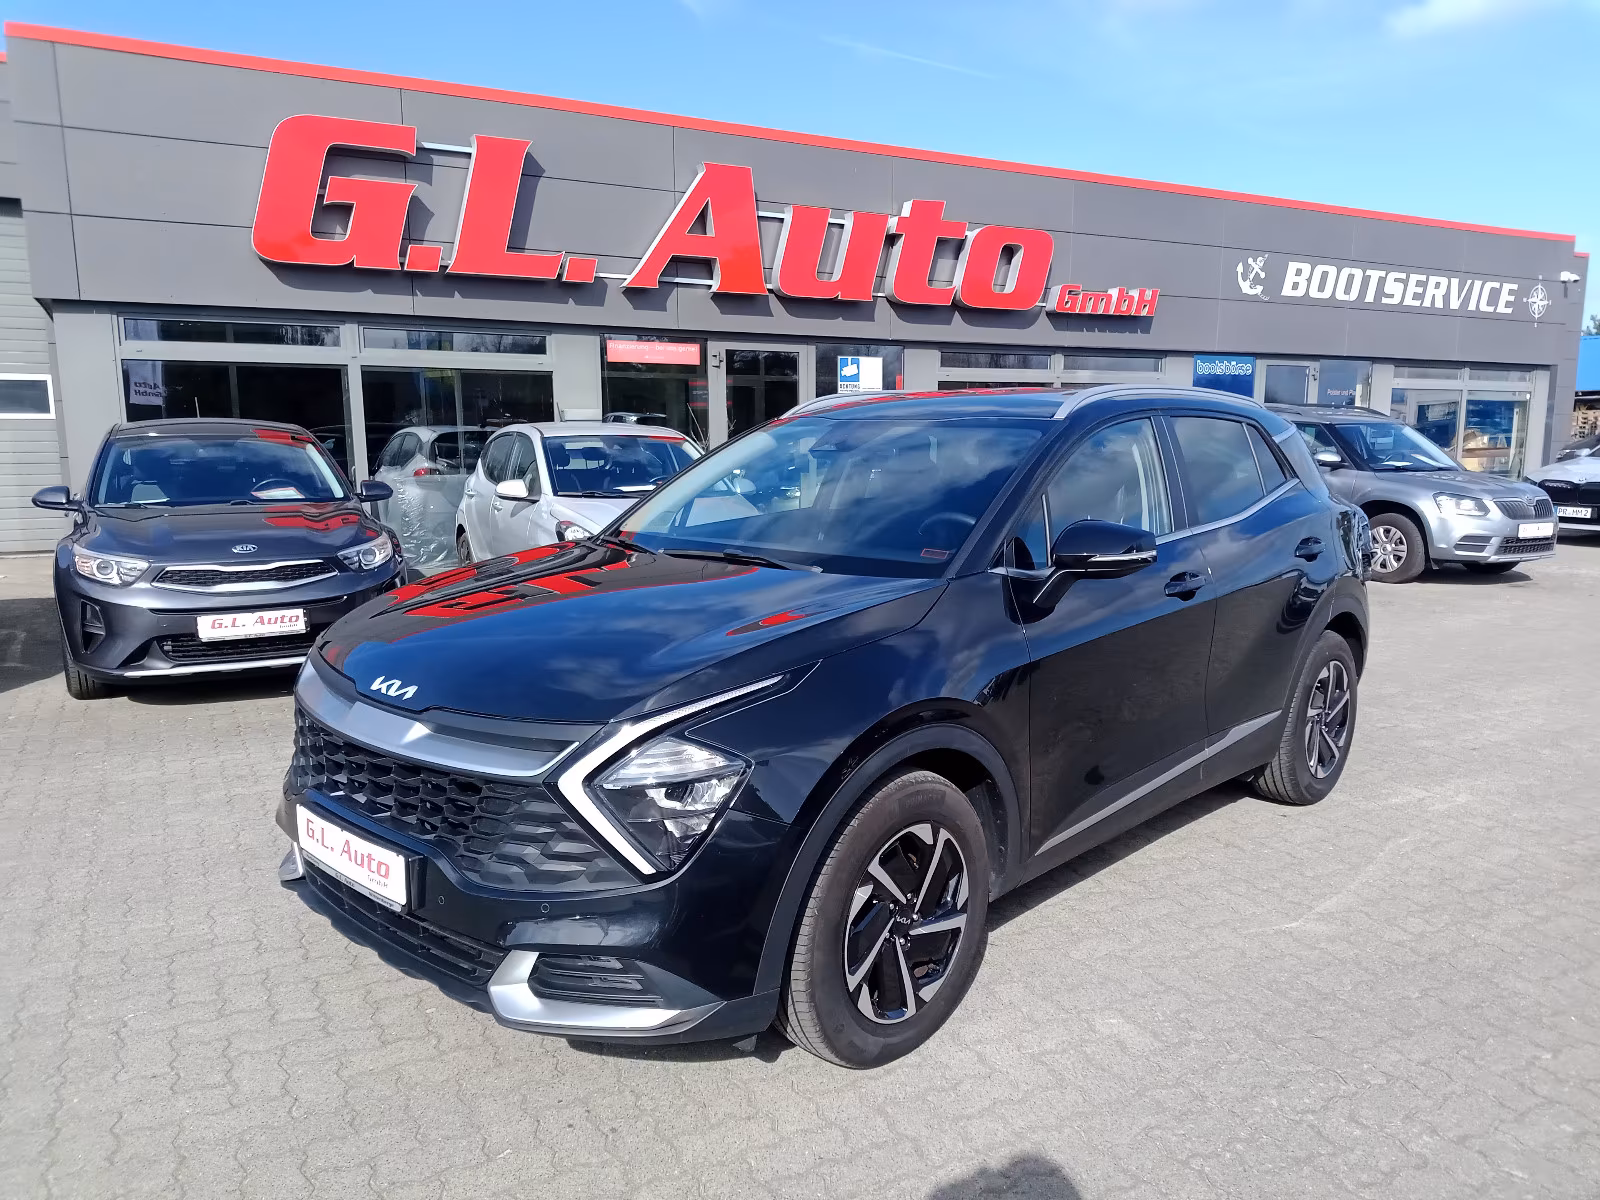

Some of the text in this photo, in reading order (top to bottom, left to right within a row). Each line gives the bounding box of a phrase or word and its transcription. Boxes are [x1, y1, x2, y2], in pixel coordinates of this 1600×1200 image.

[251, 113, 1160, 317] G.L. Auto GmbH
[1281, 261, 1518, 314] BOOTSERVICE
[1196, 360, 1253, 376] bootsbörse
[211, 617, 246, 630] G.L.
[253, 614, 300, 627] Auto
[306, 817, 390, 880] G.L. Auto
